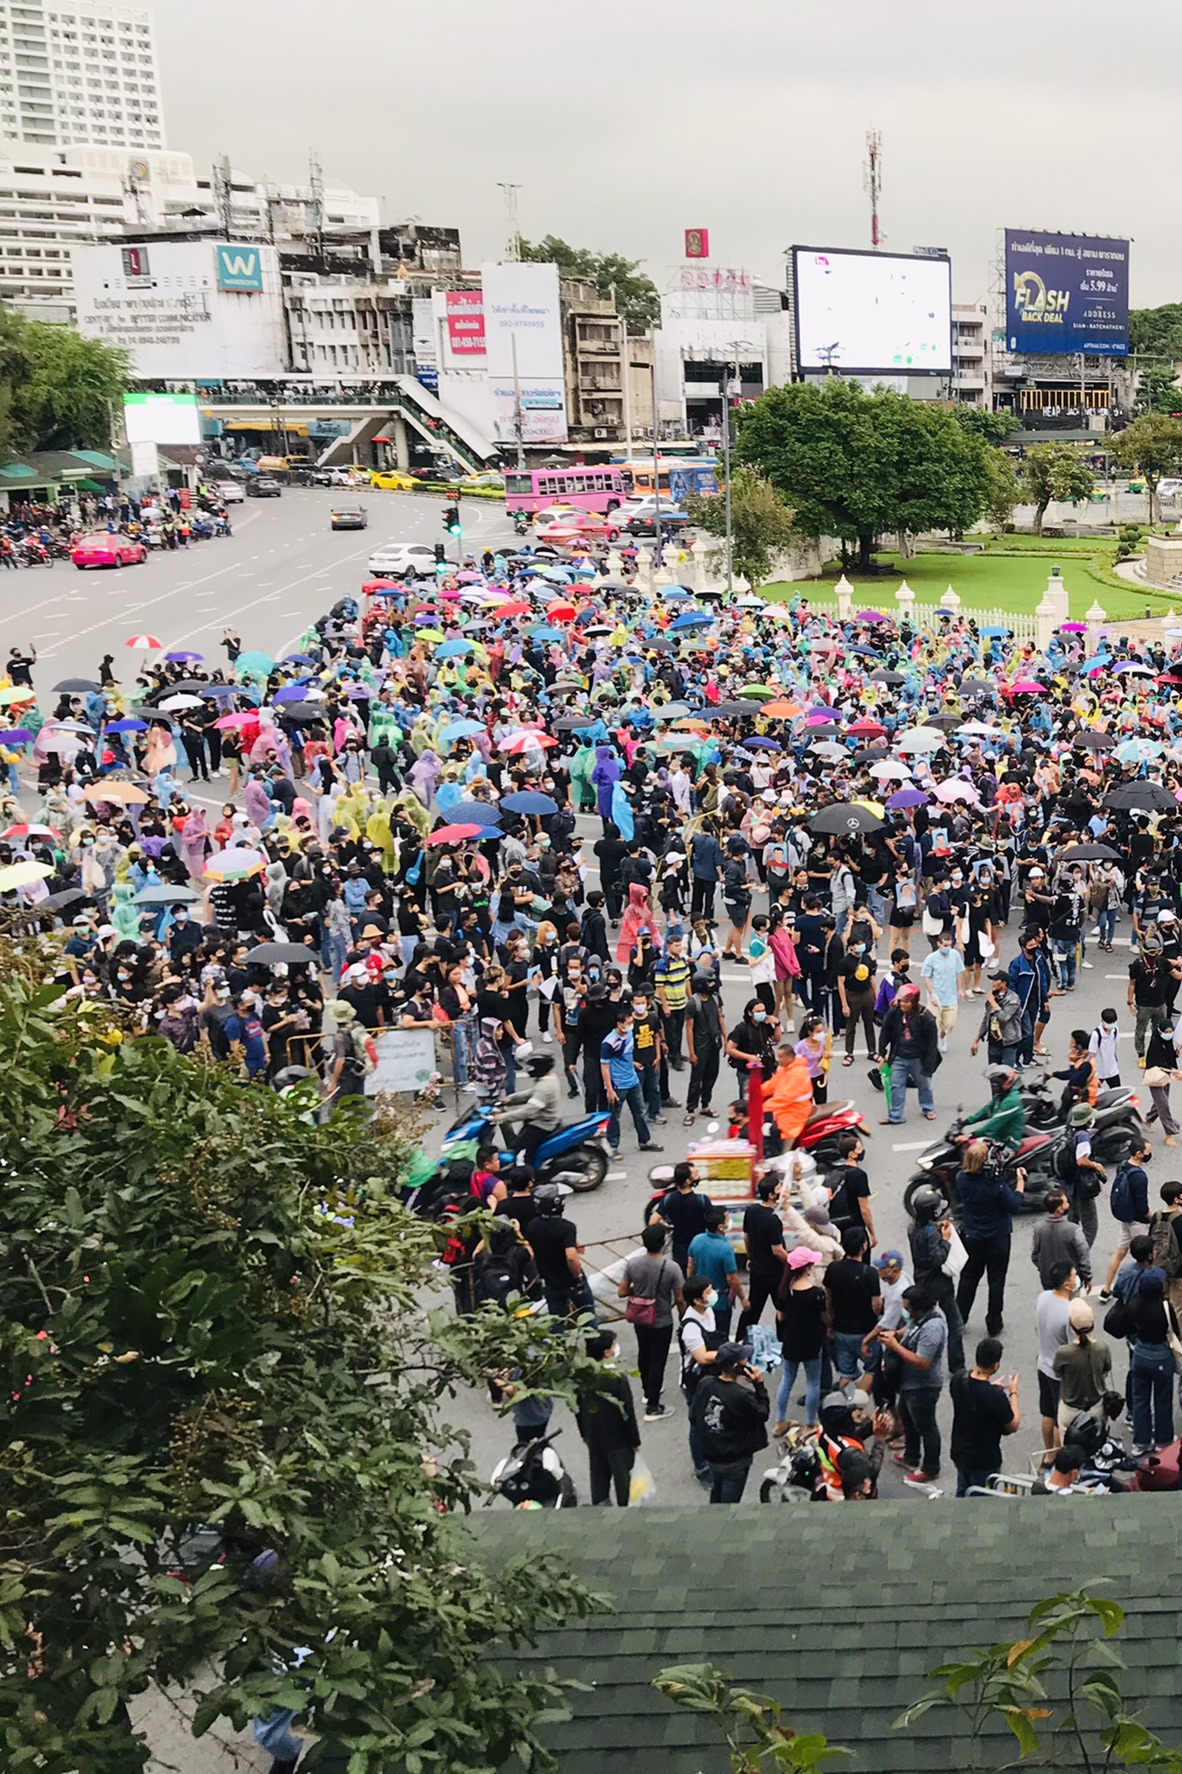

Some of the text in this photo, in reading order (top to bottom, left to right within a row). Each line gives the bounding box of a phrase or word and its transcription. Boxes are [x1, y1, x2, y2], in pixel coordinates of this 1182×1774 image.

[223, 278, 259, 287] watsons
[1090, 280, 1106, 292] 5.99
[1014, 287, 1070, 312] FLASH
[1021, 311, 1064, 324] BACK DEAL
[1083, 310, 1116, 319] ADDRESS
